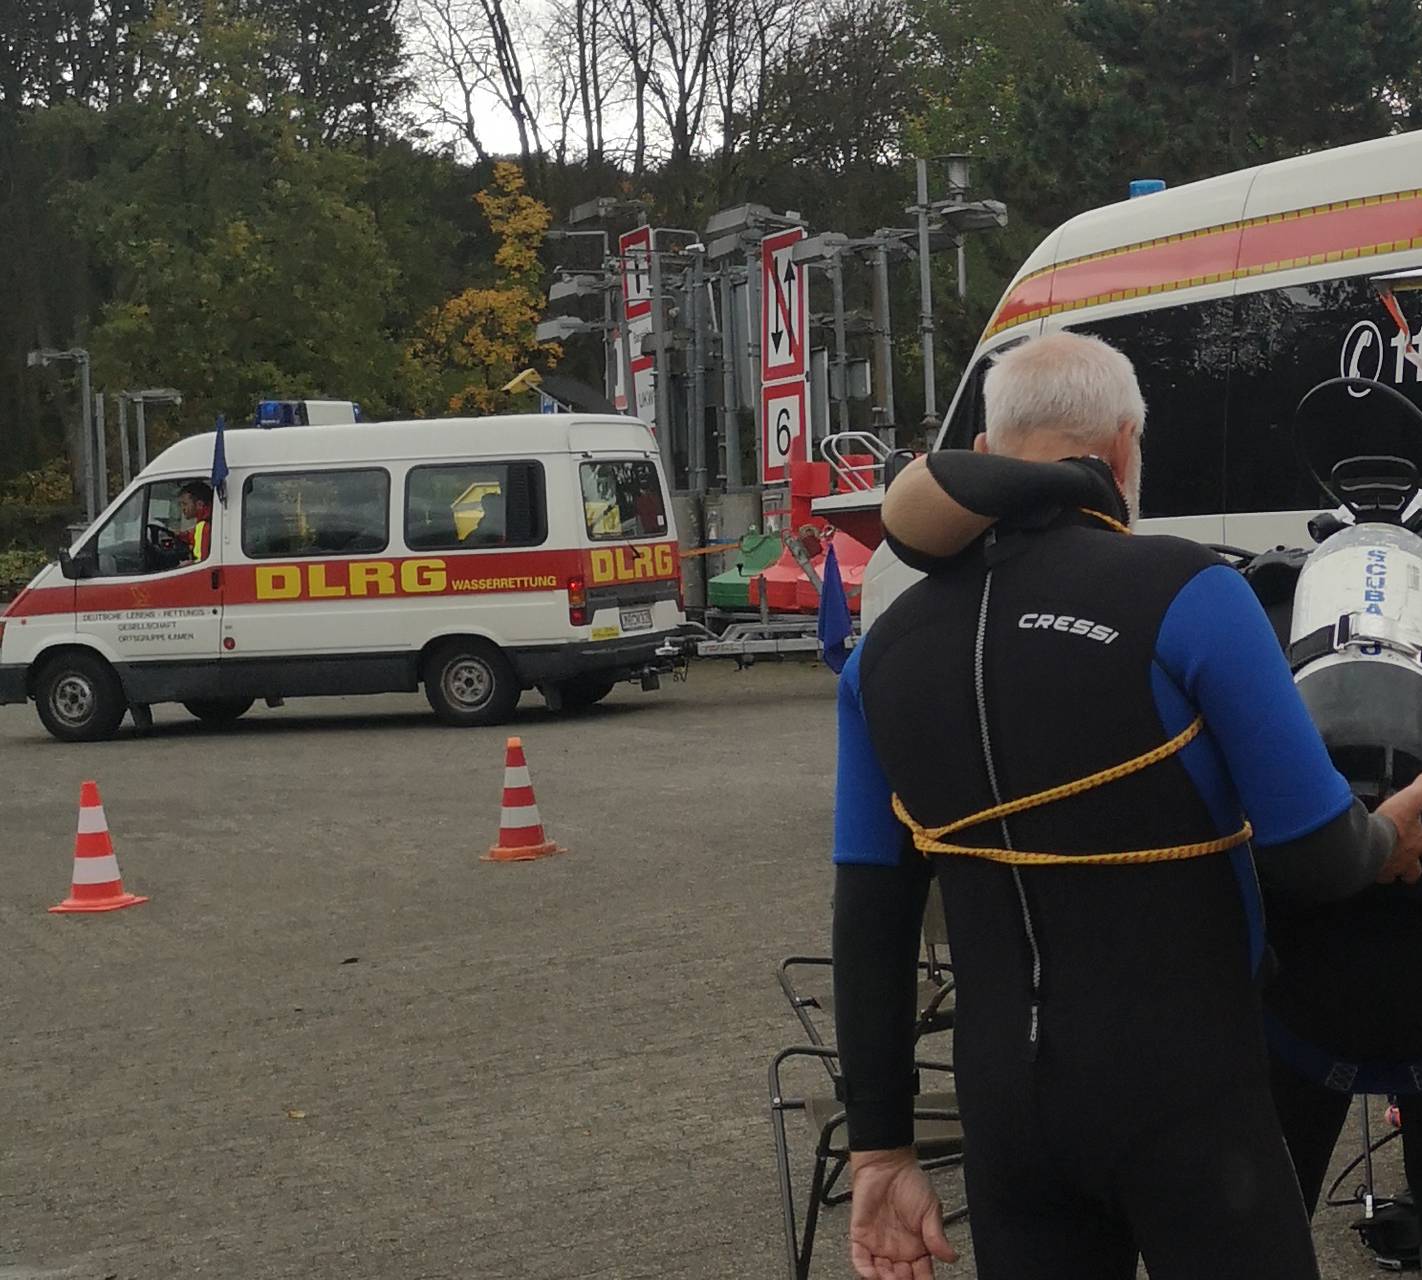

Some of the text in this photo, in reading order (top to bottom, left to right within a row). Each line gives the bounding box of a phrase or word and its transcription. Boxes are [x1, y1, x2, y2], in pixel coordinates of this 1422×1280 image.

[776, 408, 791, 456] 6
[255, 559, 557, 600] DLRG WASSERRETTUNG
[591, 544, 673, 583] DLRG
[1364, 549, 1387, 616] SCUBA
[118, 621, 177, 631] GESELLSCHAFT
[1018, 613, 1120, 644] CRESSI
